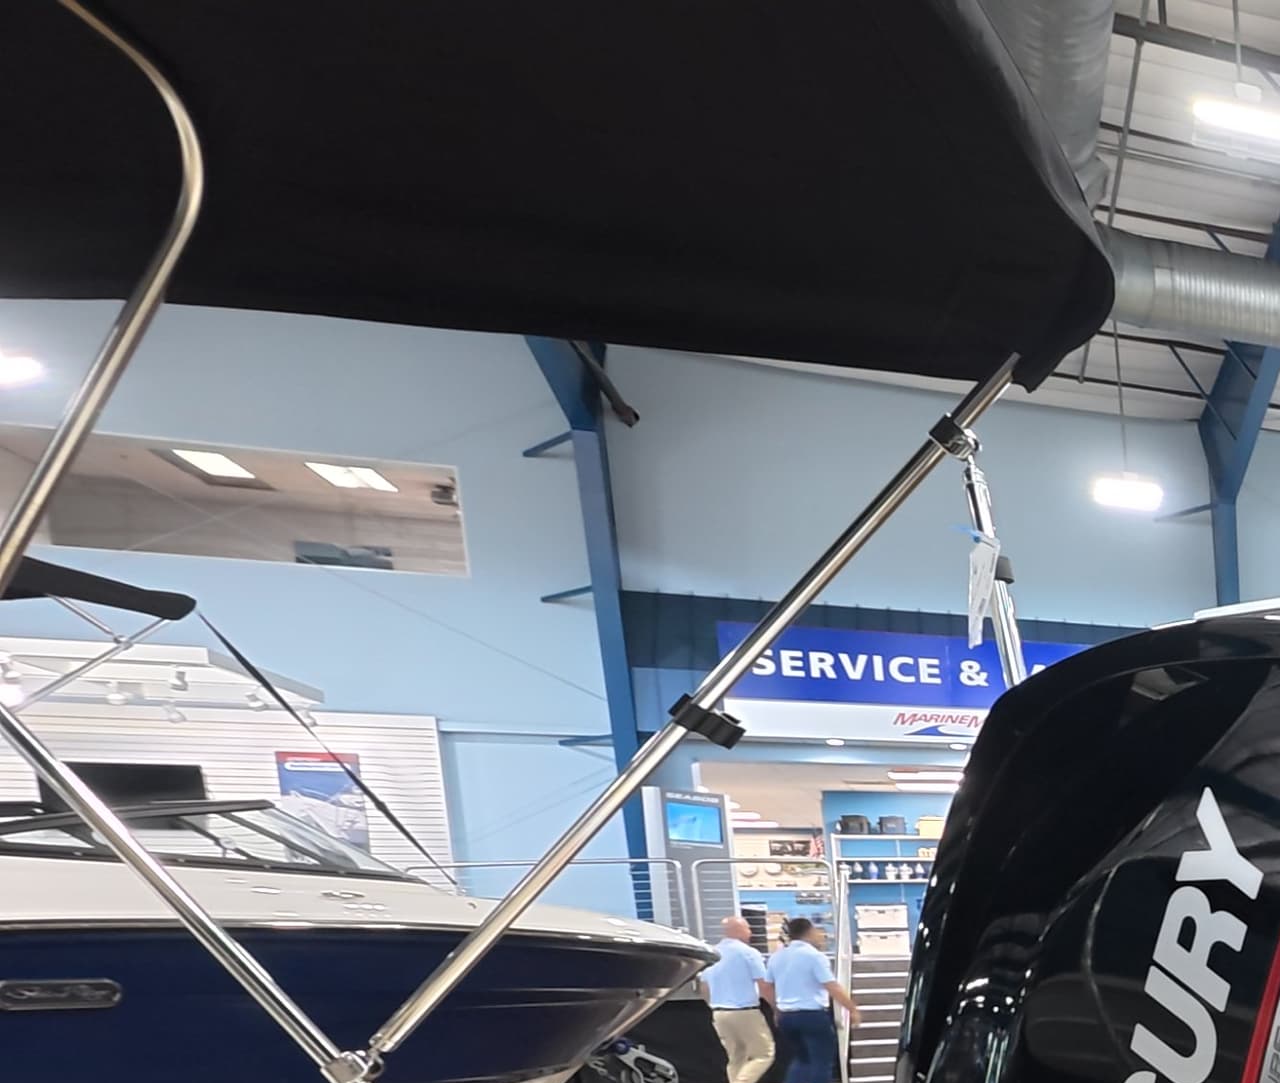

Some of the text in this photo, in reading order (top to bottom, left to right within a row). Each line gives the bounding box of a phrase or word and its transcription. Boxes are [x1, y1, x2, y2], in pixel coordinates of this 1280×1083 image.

[751, 649, 988, 687] SERVICE &
[893, 712, 983, 729] MARINEM
